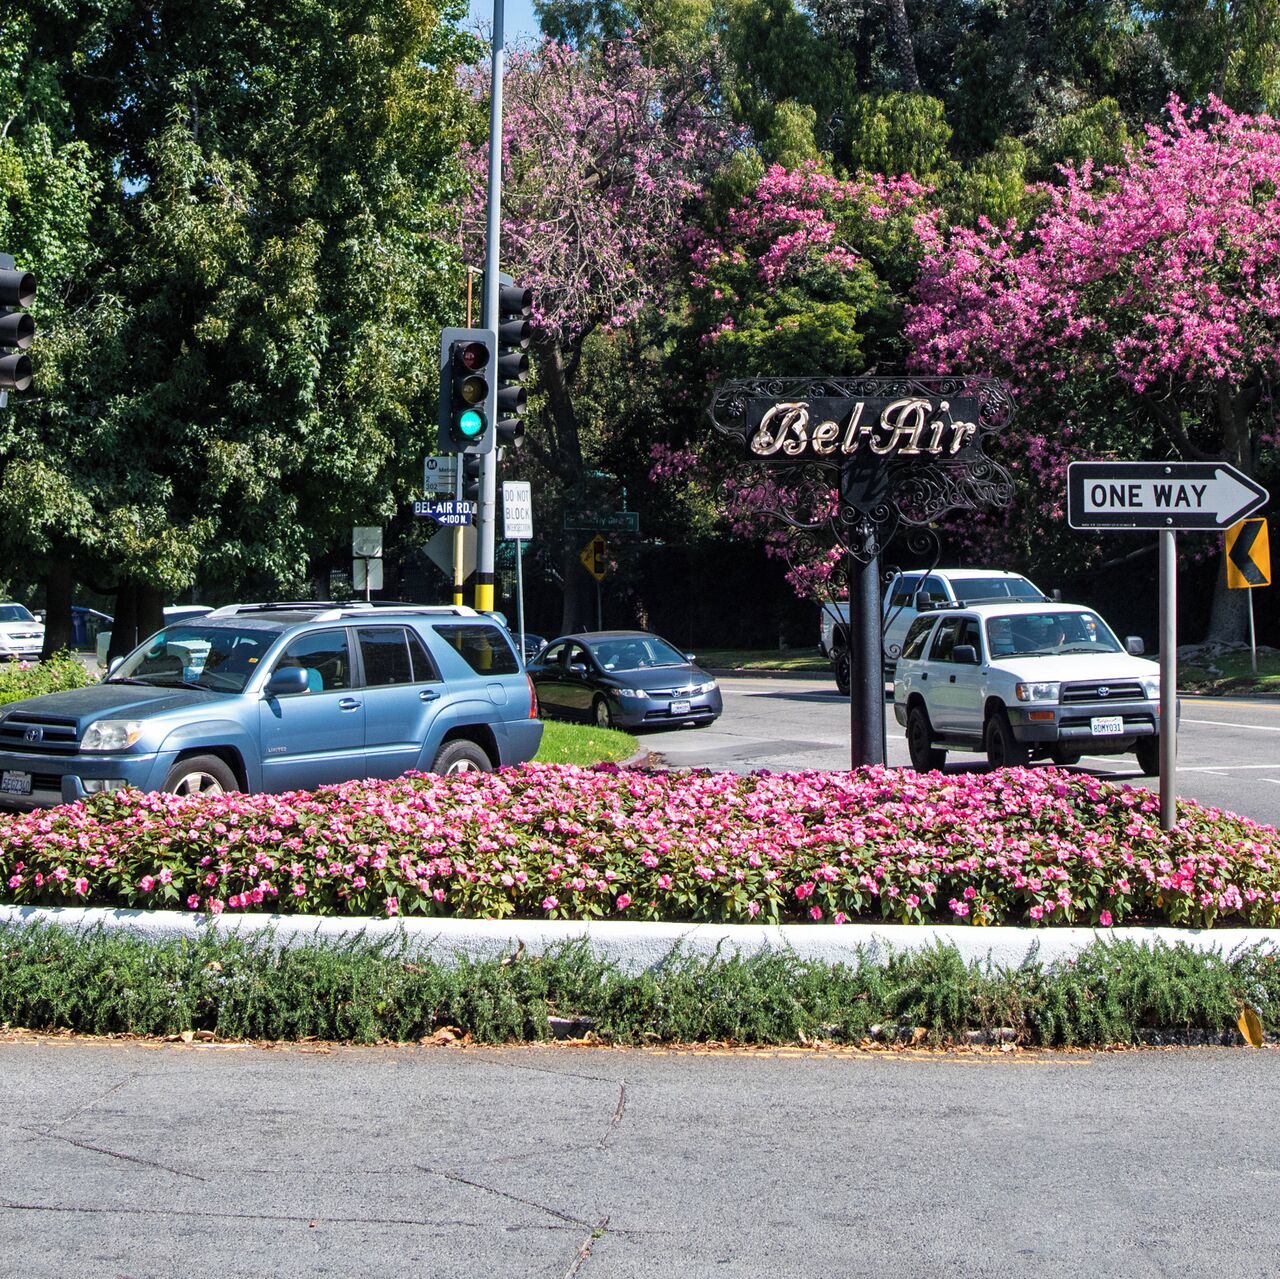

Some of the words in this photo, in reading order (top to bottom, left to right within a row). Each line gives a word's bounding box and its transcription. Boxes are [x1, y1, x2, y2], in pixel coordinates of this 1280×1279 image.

[751, 397, 976, 455] Bel-Air
[428, 460, 437, 469] M
[505, 490, 514, 502] DO
[517, 490, 529, 502] NOT
[1091, 484, 1143, 508] ONE
[1153, 484, 1207, 508] WAY
[414, 501, 453, 514] BEL-AIR
[456, 502, 472, 514] RD.
[506, 507, 530, 520] BLOCK
[447, 515, 460, 524] 100
[460, 515, 468, 524] N.
